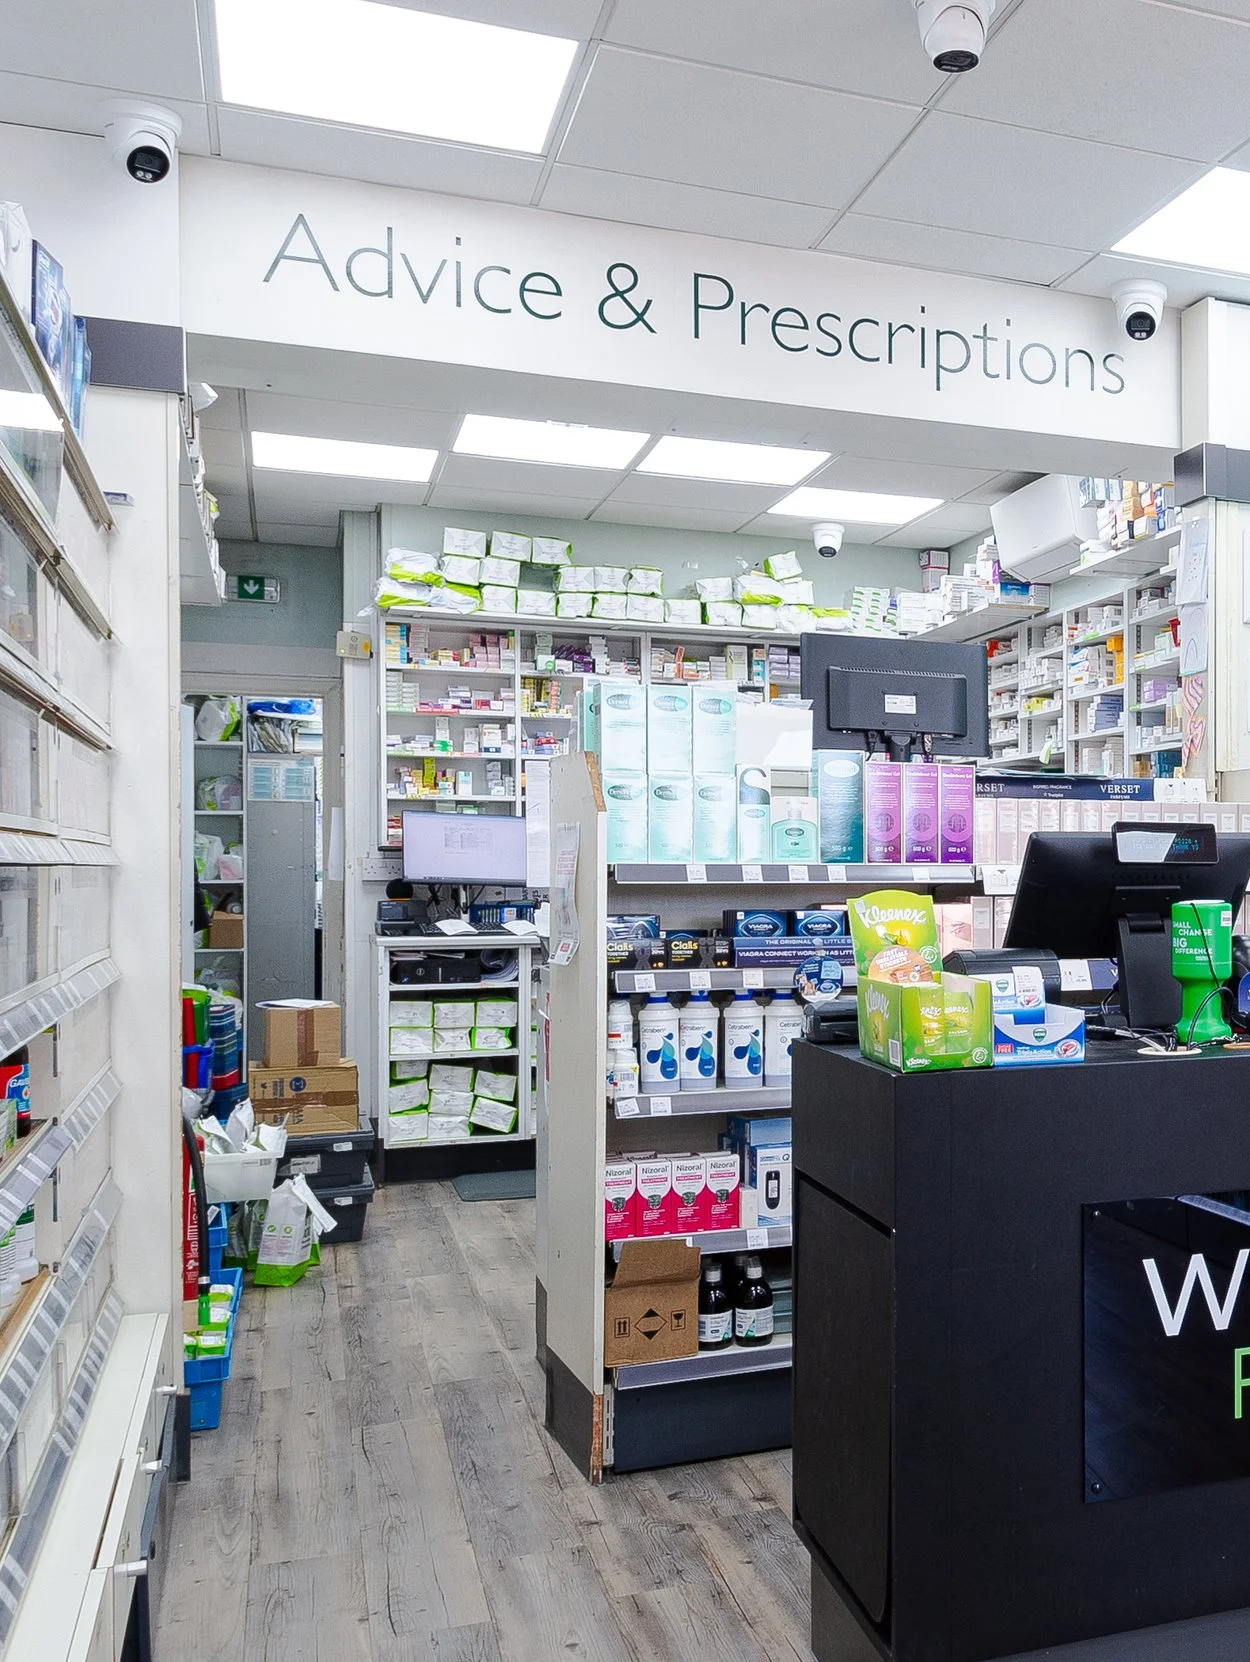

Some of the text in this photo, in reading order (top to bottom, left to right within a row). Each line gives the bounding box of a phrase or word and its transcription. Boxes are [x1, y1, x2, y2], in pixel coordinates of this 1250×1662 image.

[262, 213, 1127, 394] Advice & Prescriptions
[1100, 784, 1140, 794] VERSET
[864, 907, 927, 928] Kleenex
[671, 940, 698, 950] Cialis
[1173, 937, 1187, 948] BIG
[641, 1025, 667, 1033] Cetraben
[641, 1165, 668, 1175] Nizoral
[676, 1163, 702, 1172] Nizoral
[709, 1160, 736, 1170] Nizoral
[605, 1168, 632, 1177] Nizoral
